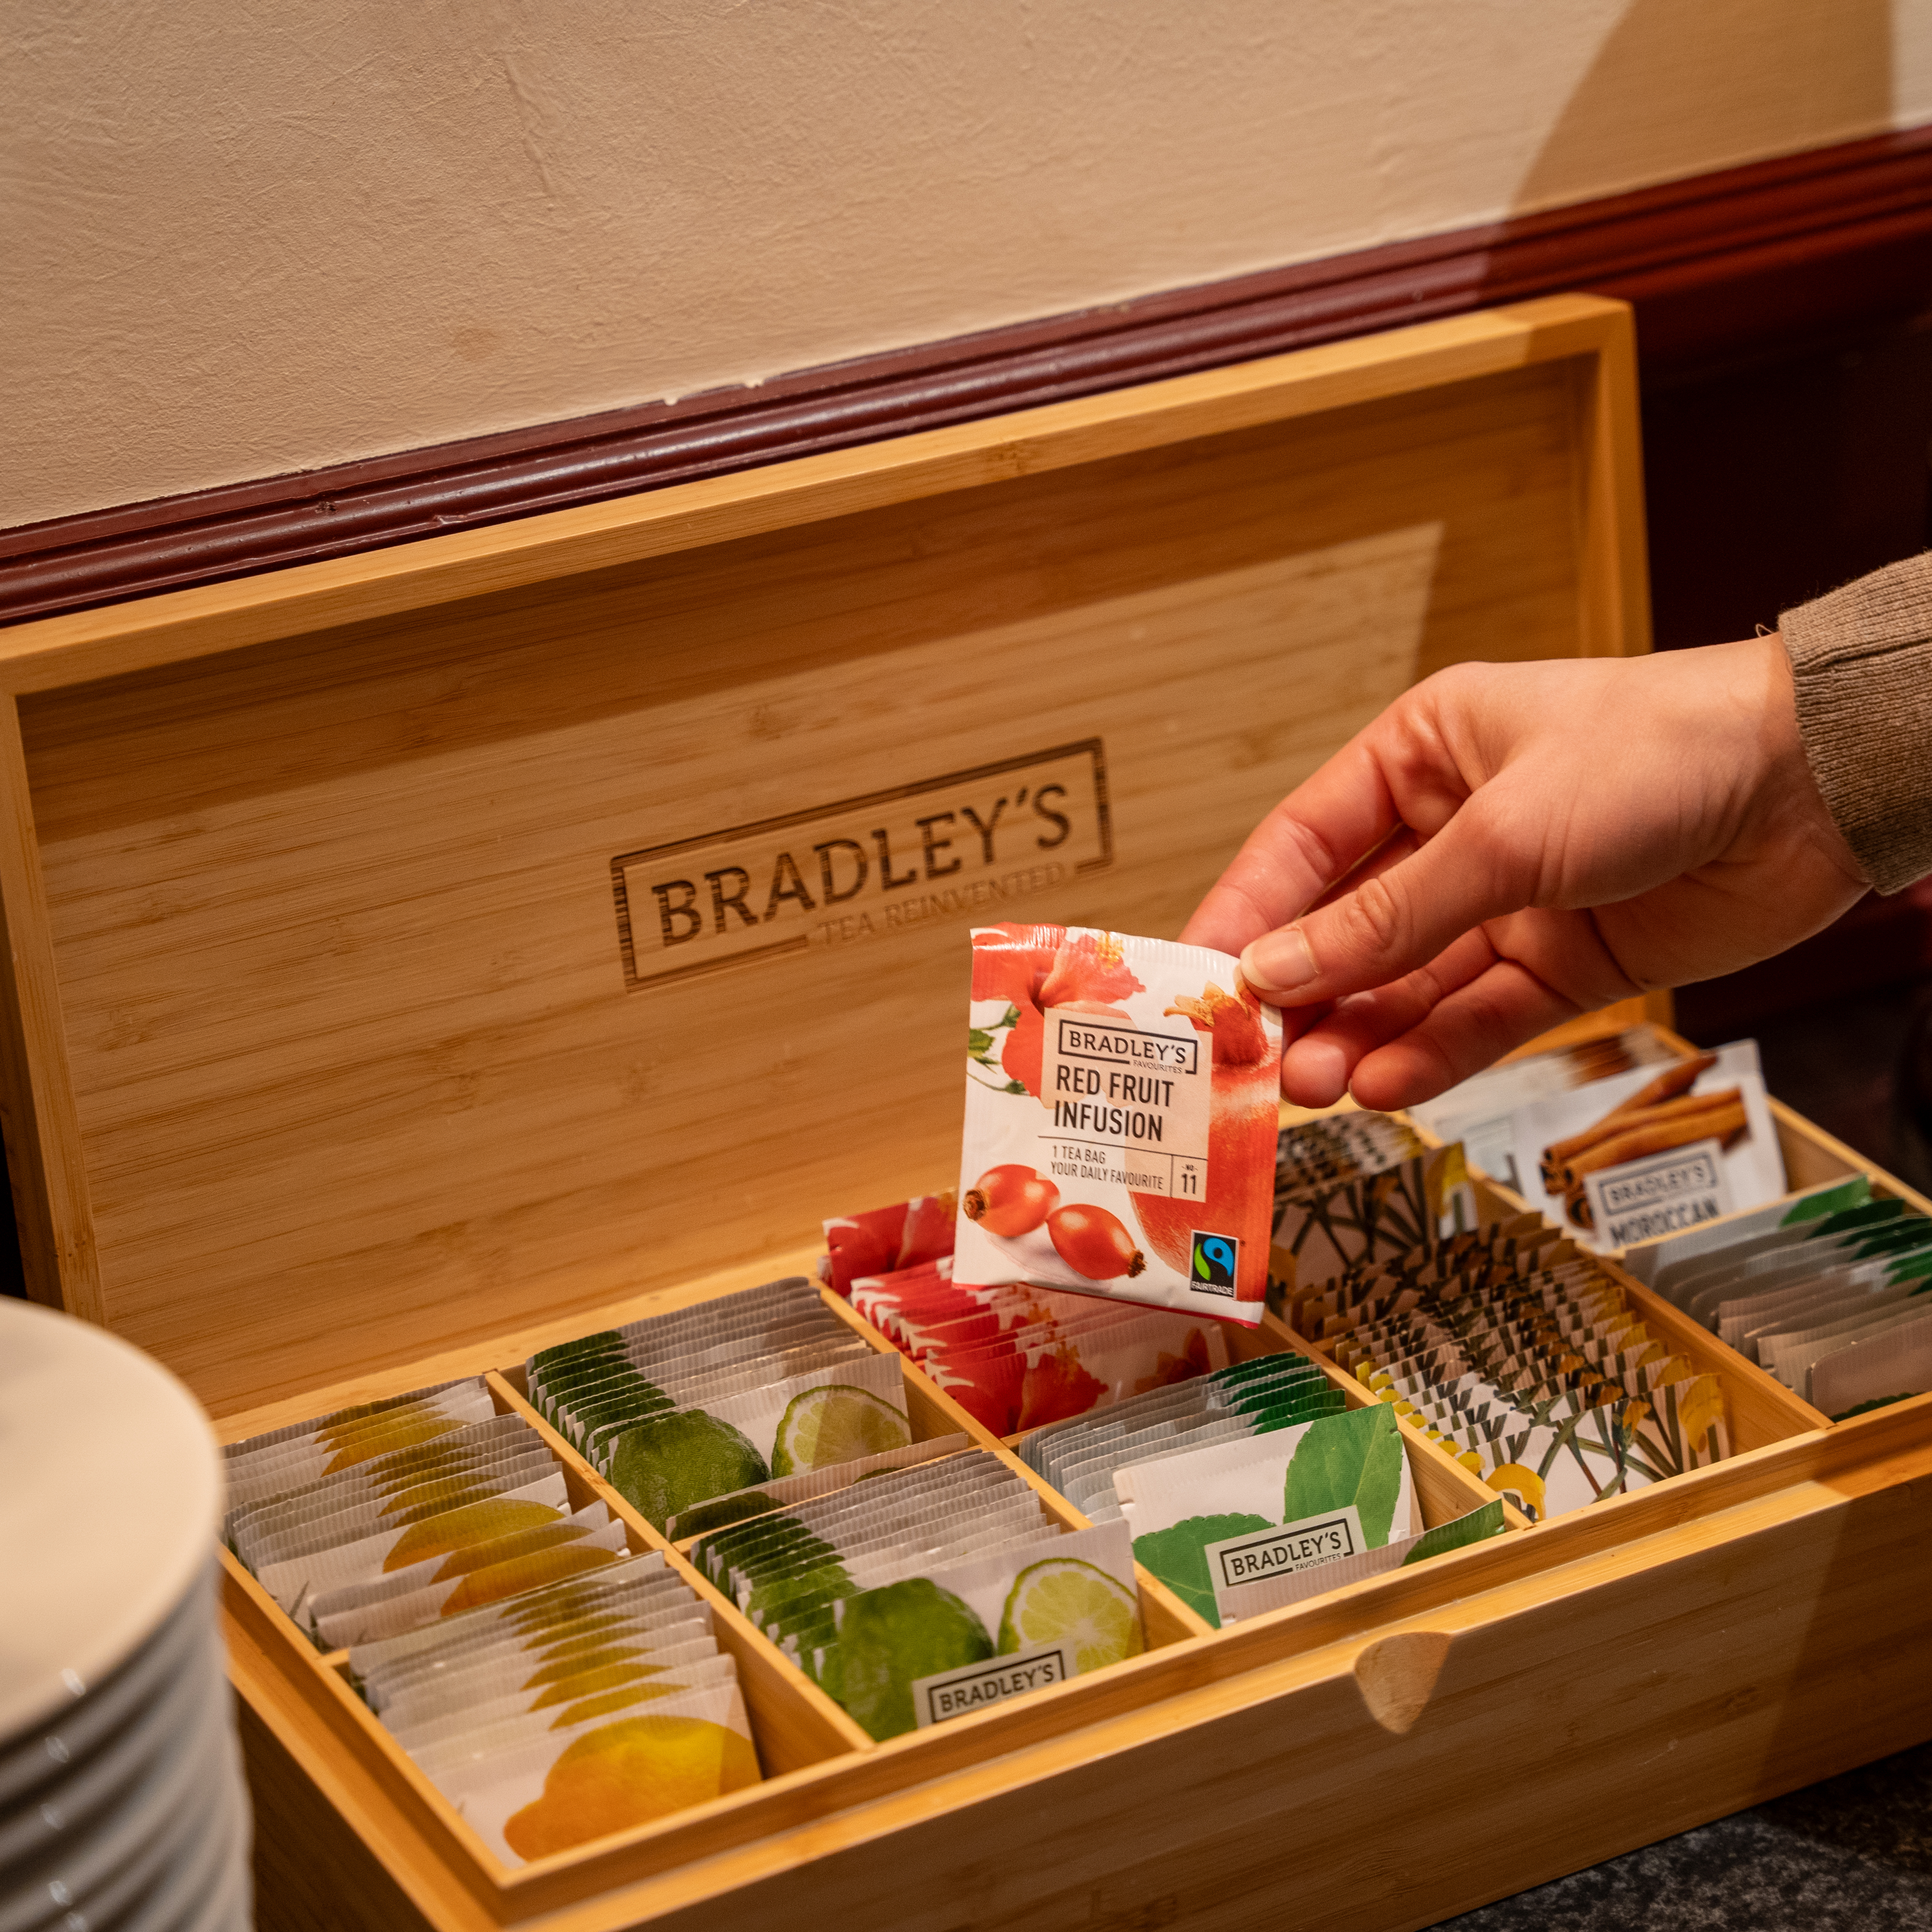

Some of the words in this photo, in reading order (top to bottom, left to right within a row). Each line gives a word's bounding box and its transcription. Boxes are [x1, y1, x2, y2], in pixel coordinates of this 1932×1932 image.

[651, 783, 1072, 947] BRADLEY'S
[817, 912, 875, 944] TEA
[885, 863, 1062, 927] REINVENTED
[1069, 1030, 1186, 1064] BRADLEY'S
[1056, 1064, 1100, 1095] RED
[1109, 1072, 1174, 1107] FRUIT
[1133, 1060, 1182, 1074] FAVOURITES
[1054, 1100, 1163, 1141] INFUSION
[1052, 1145, 1057, 1158] 1
[1062, 1146, 1081, 1161] TEA
[1084, 1149, 1106, 1165] BAG
[1051, 1161, 1078, 1177] YOUR
[1080, 1165, 1108, 1181] DAILY
[1110, 1169, 1164, 1190] FAVOURITE
[1181, 1173, 1197, 1194] 11
[1609, 1197, 1719, 1247] MOROCCAN
[1190, 1280, 1234, 1295] FAIRTRADE
[1230, 1531, 1341, 1577] BRADLEY'S
[1295, 1553, 1341, 1571] FAVOURITES
[939, 1663, 1054, 1713] BRADLEY'S
